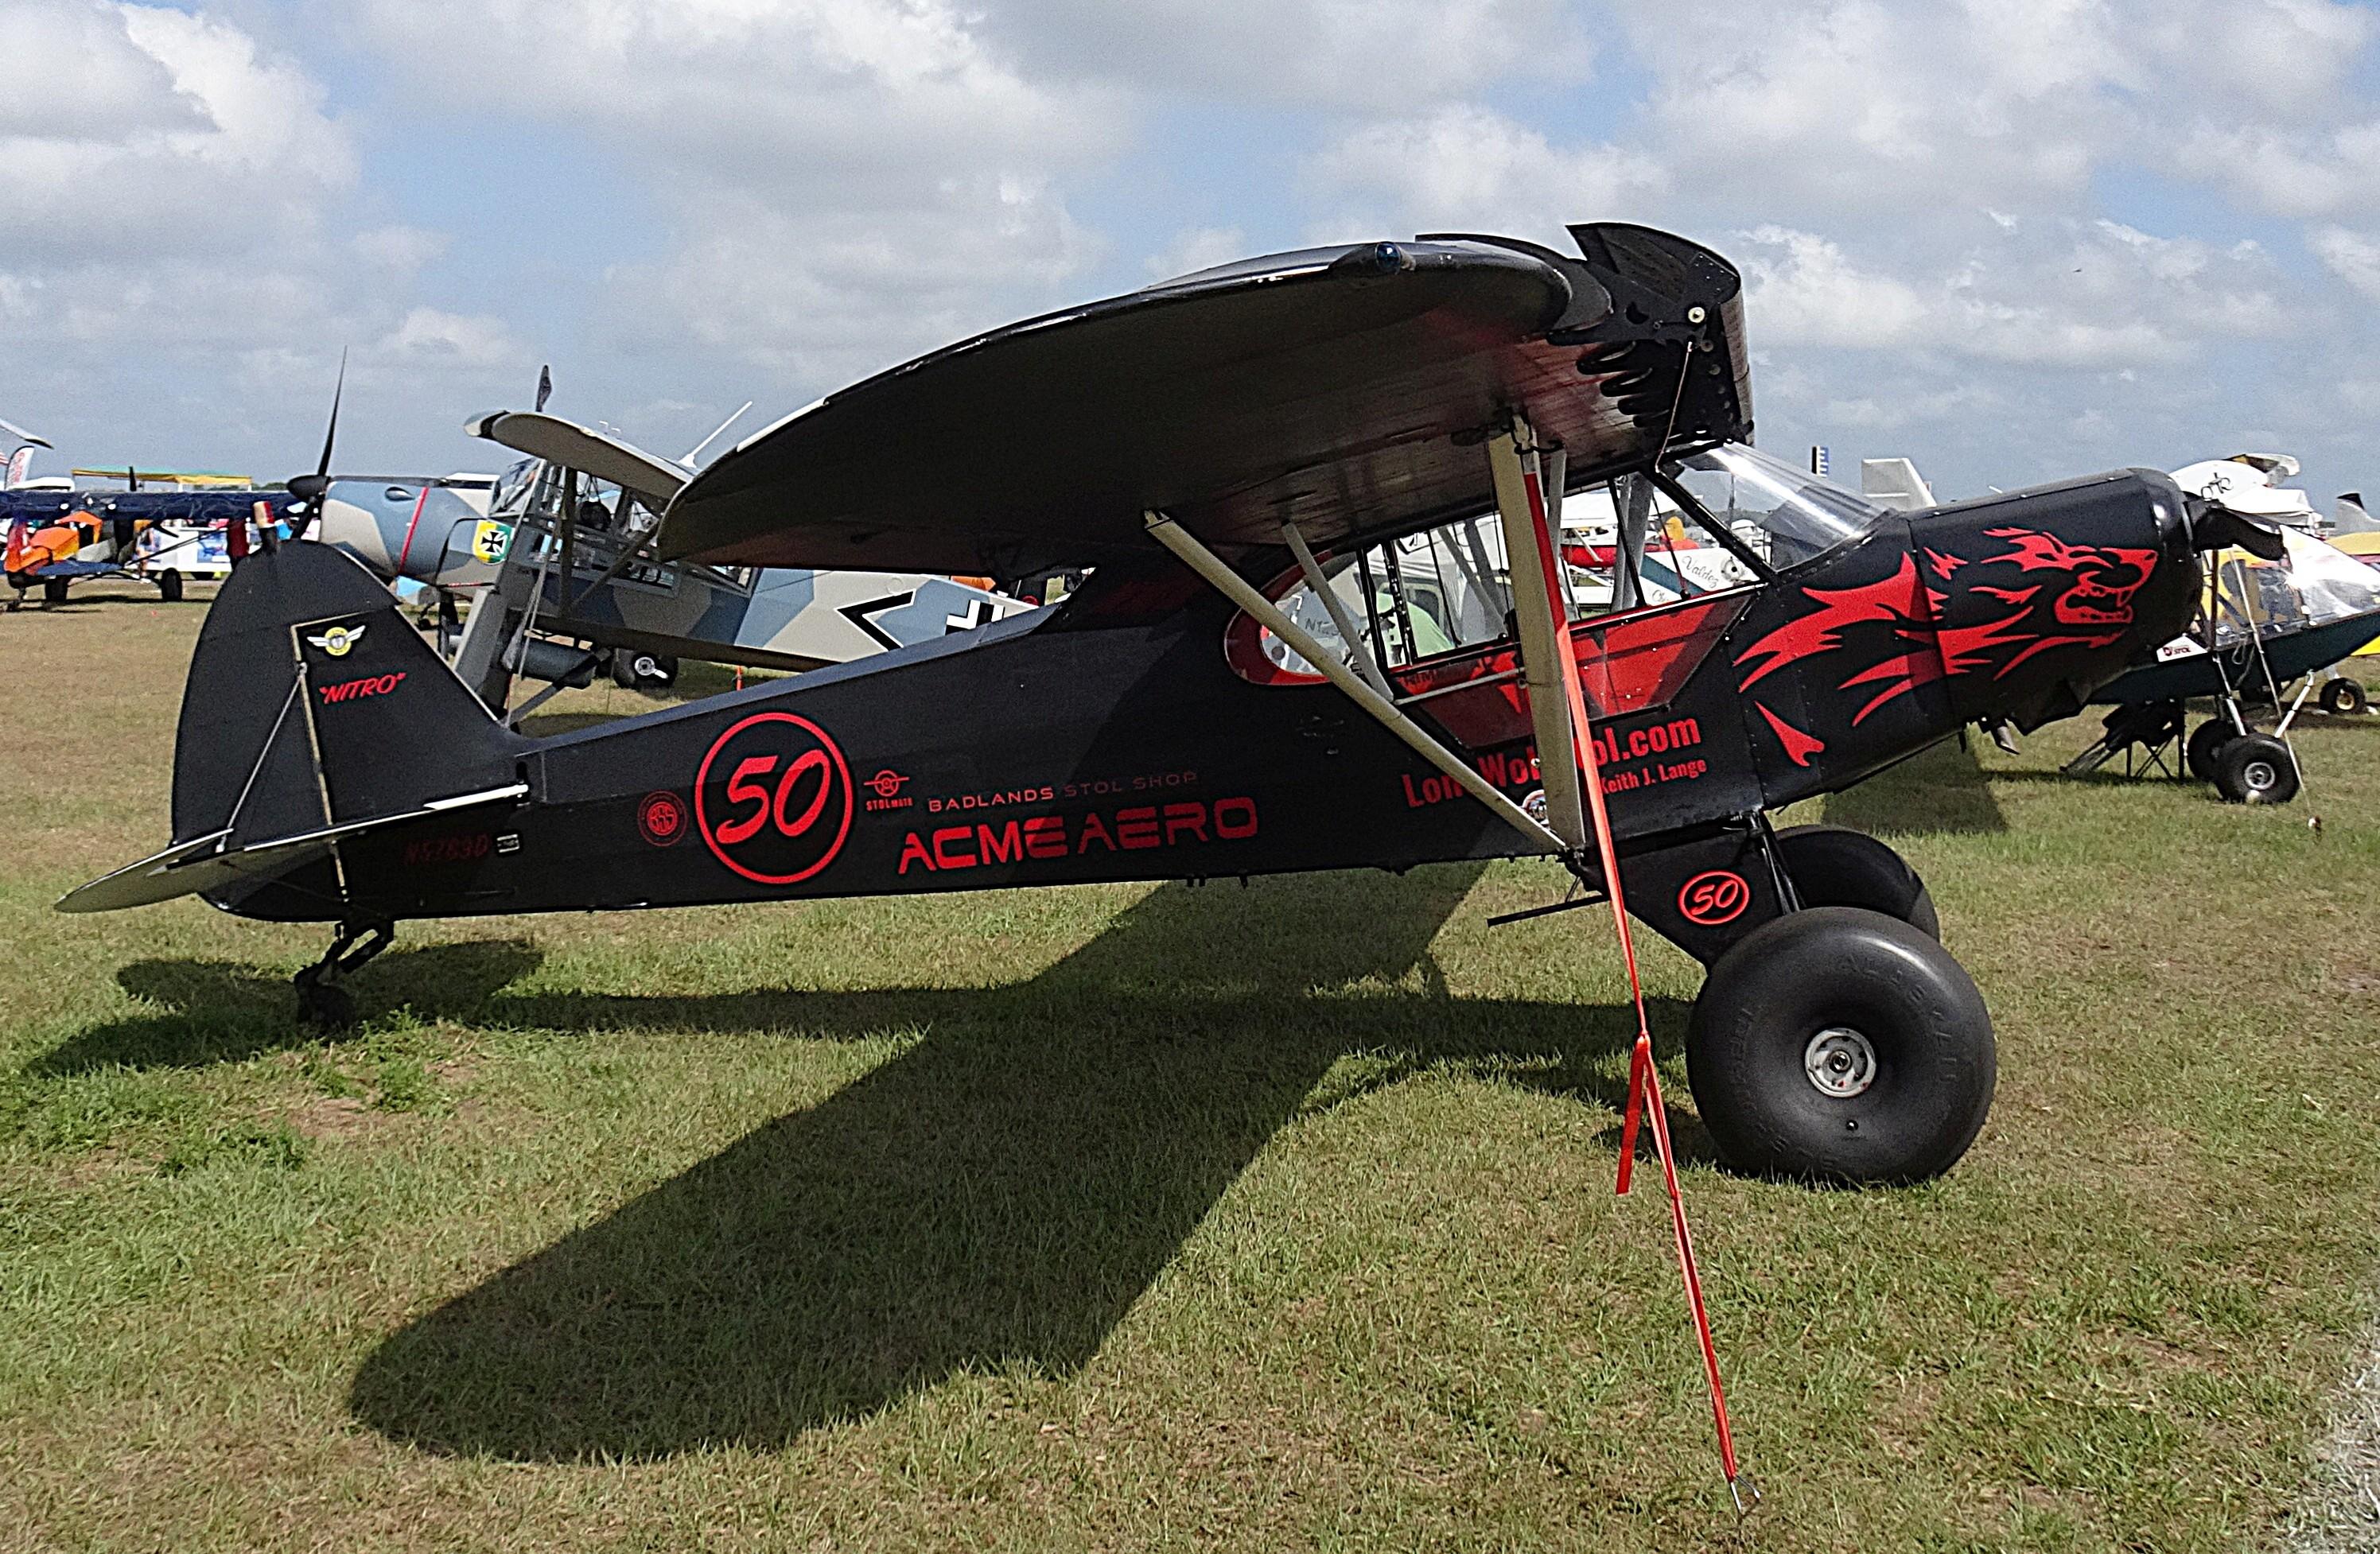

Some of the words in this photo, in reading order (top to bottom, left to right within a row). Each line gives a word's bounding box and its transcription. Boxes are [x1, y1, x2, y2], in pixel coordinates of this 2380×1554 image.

[929, 787, 1054, 812] BADLANDS
[1063, 781, 1122, 797] STOL
[1132, 770, 1197, 790] SHOP
[1641, 767, 1656, 786] J.
[1657, 759, 1707, 782] Lange
[716, 748, 831, 844] 50
[898, 816, 1068, 874] ACME
[1077, 796, 1258, 854] AERO
[1691, 879, 1739, 915] 50
